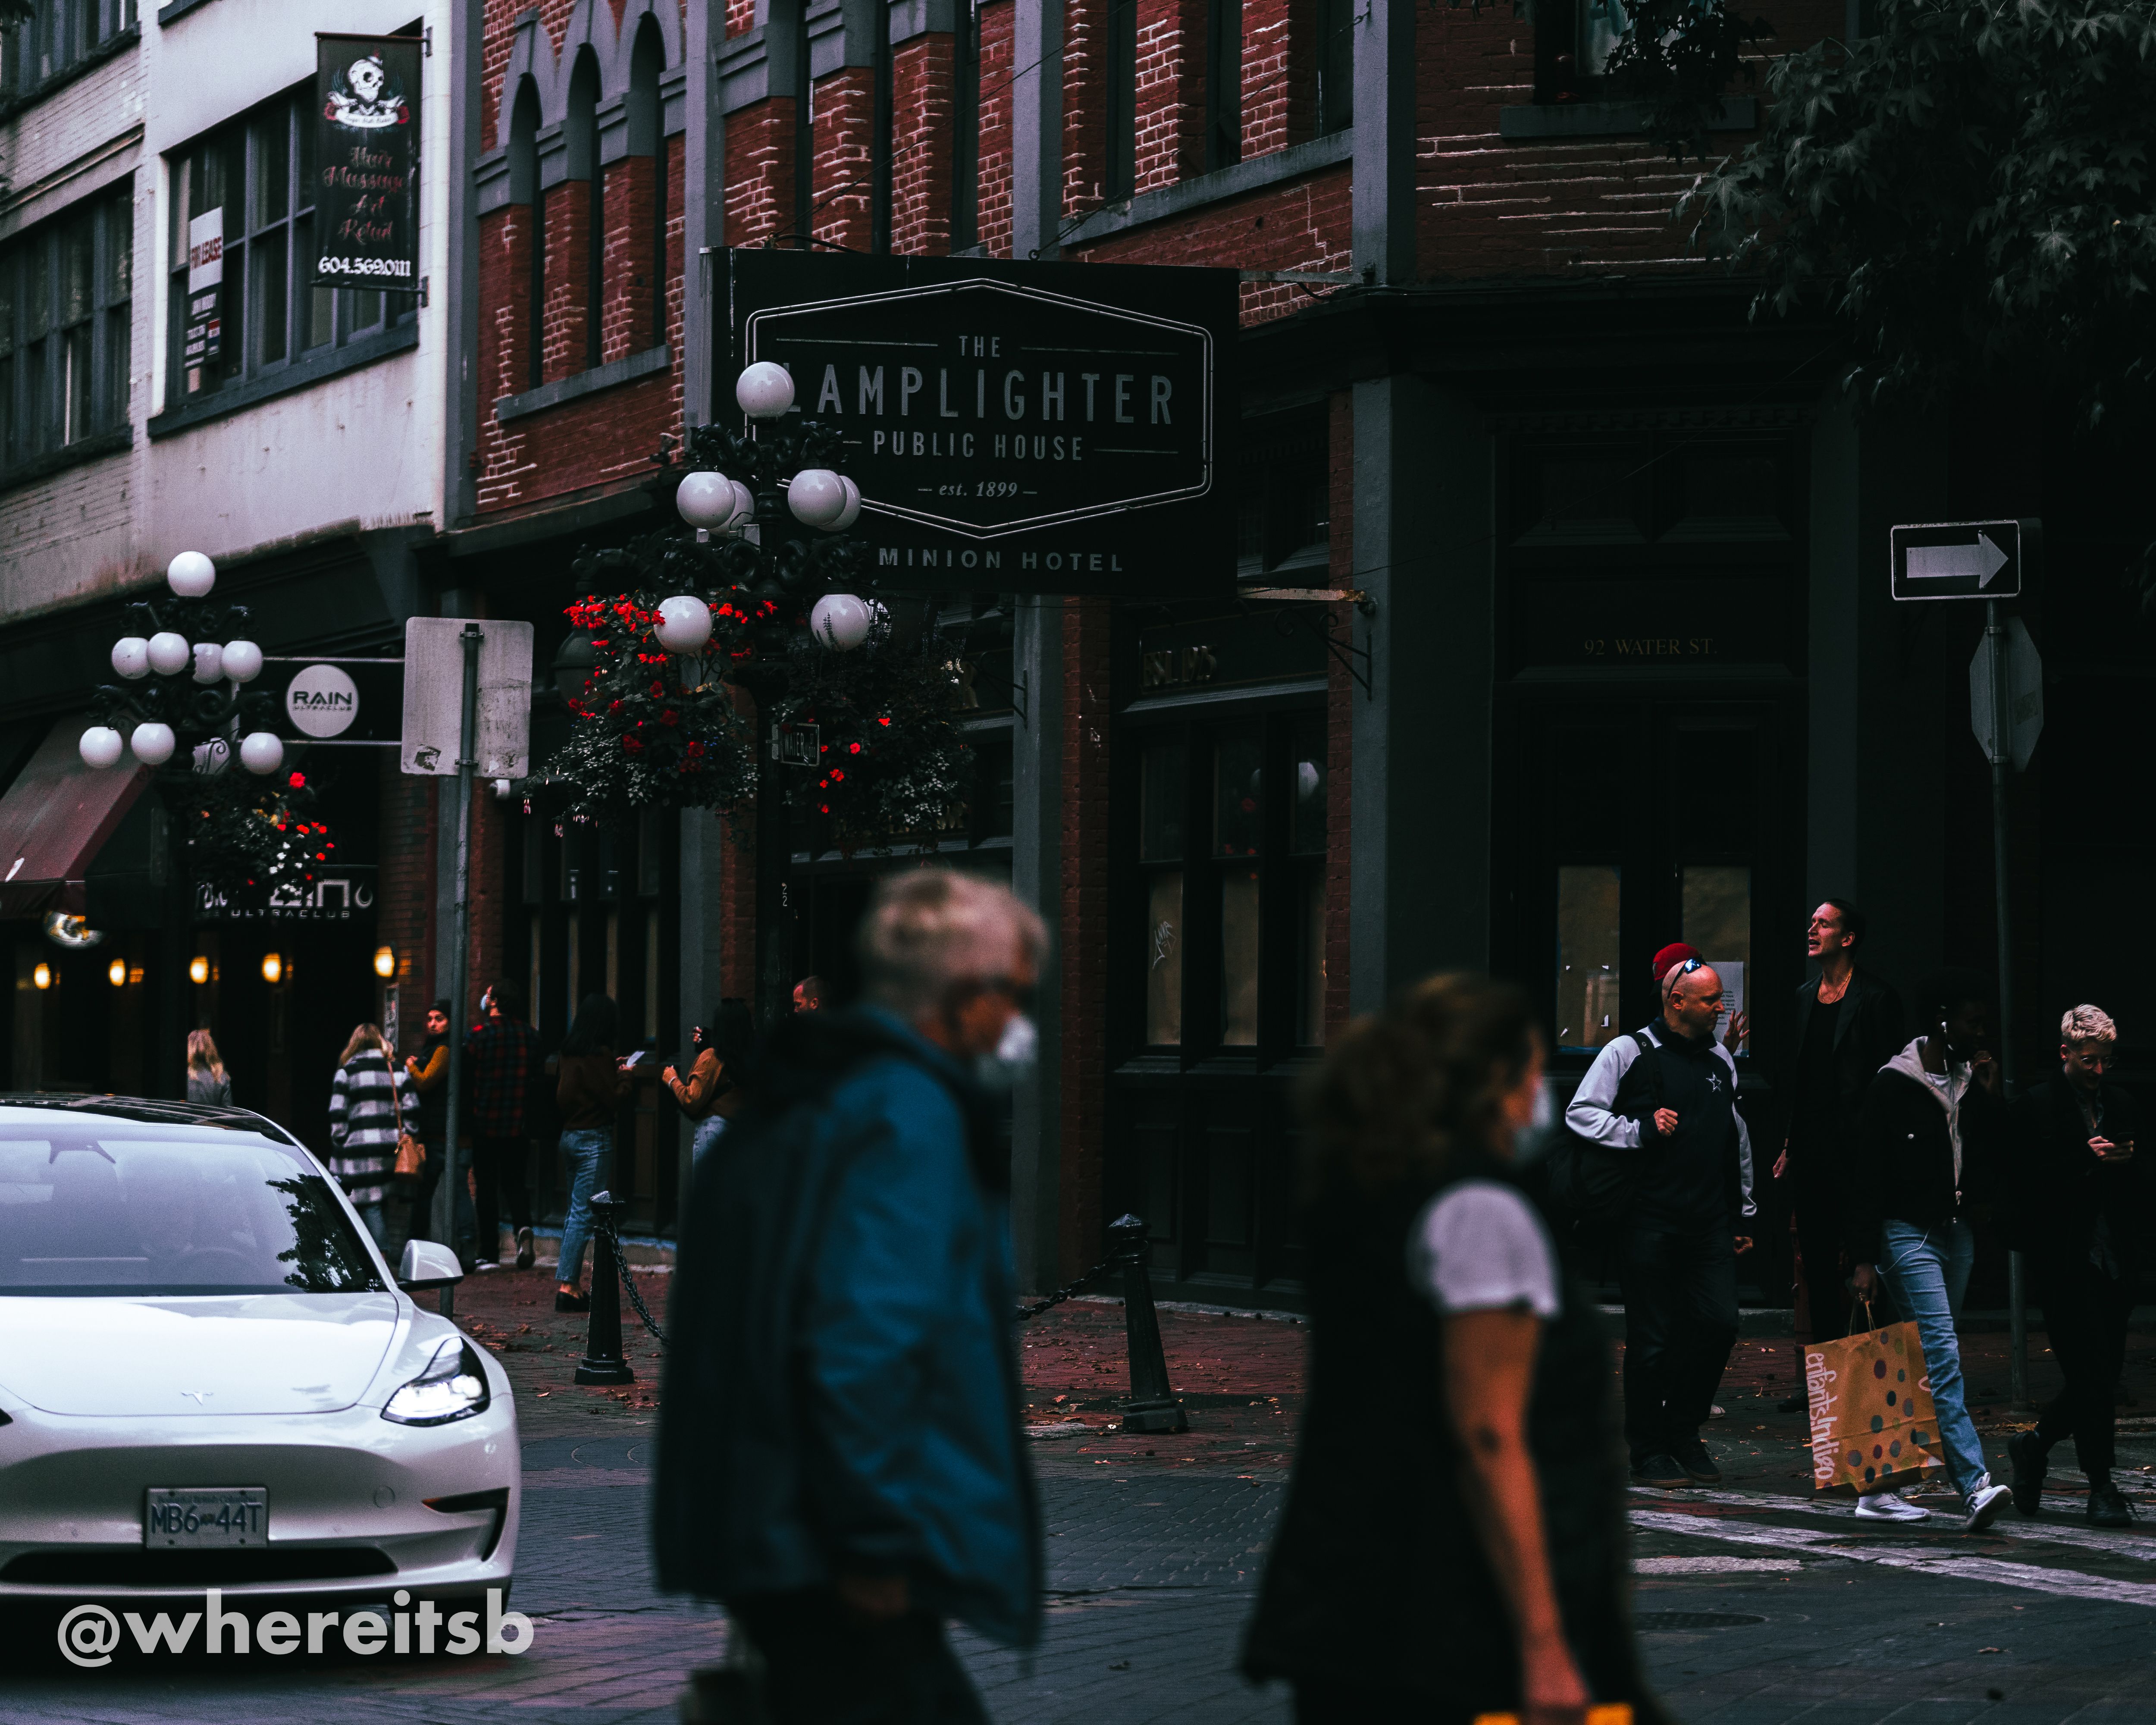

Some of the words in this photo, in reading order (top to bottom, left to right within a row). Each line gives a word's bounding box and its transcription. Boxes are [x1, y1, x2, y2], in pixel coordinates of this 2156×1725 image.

[959, 335, 1001, 358] THE
[874, 430, 974, 458] PUBLIC
[995, 434, 1083, 461] HOUSE
[939, 483, 967, 497] est.
[976, 481, 1018, 498] 1899
[1022, 552, 1122, 572] HOTEL
[1584, 640, 1605, 656] 92
[1615, 639, 1682, 656] WATER
[1689, 638, 1718, 655] ST.
[294, 691, 352, 704] RAIN
[230, 908, 351, 919] ULTRACLUB
[151, 1502, 200, 1534] MB6
[216, 1502, 263, 1534] 44T
